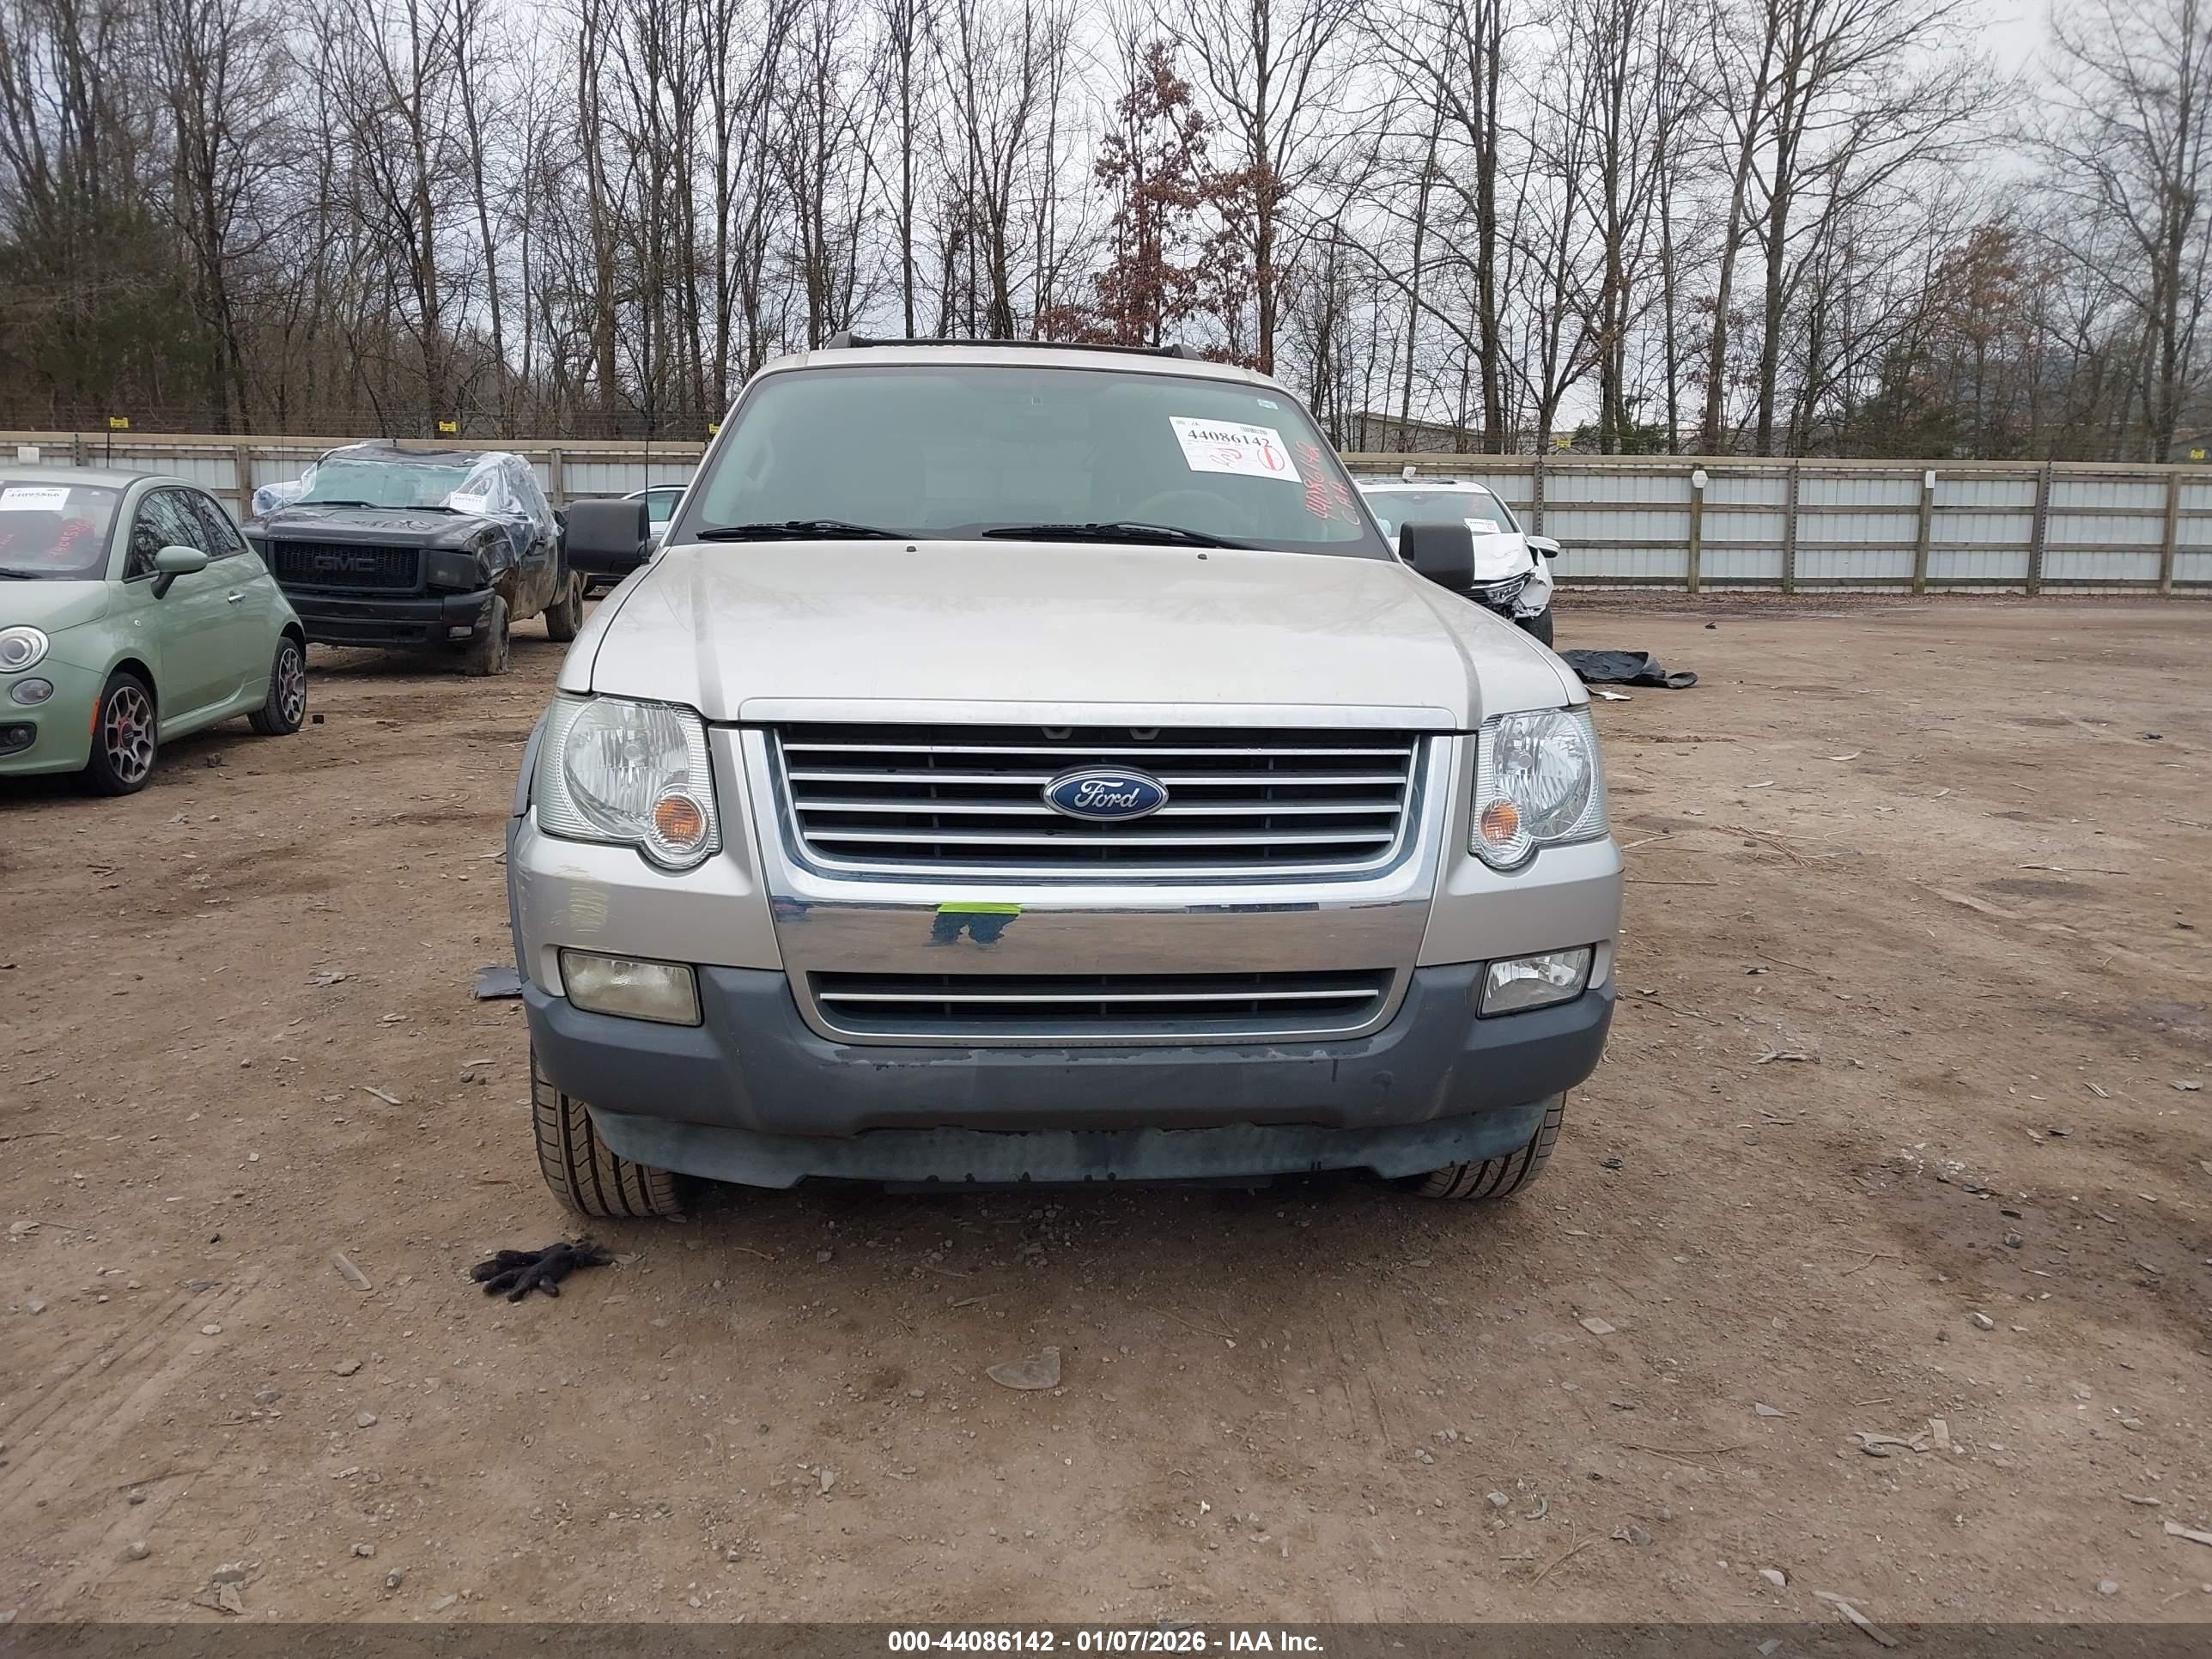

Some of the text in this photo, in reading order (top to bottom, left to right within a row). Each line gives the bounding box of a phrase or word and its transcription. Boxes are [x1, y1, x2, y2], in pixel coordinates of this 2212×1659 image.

[1188, 429, 1273, 447] 44086142
[314, 556, 376, 573] GMC
[1074, 780, 1141, 808] Ford
